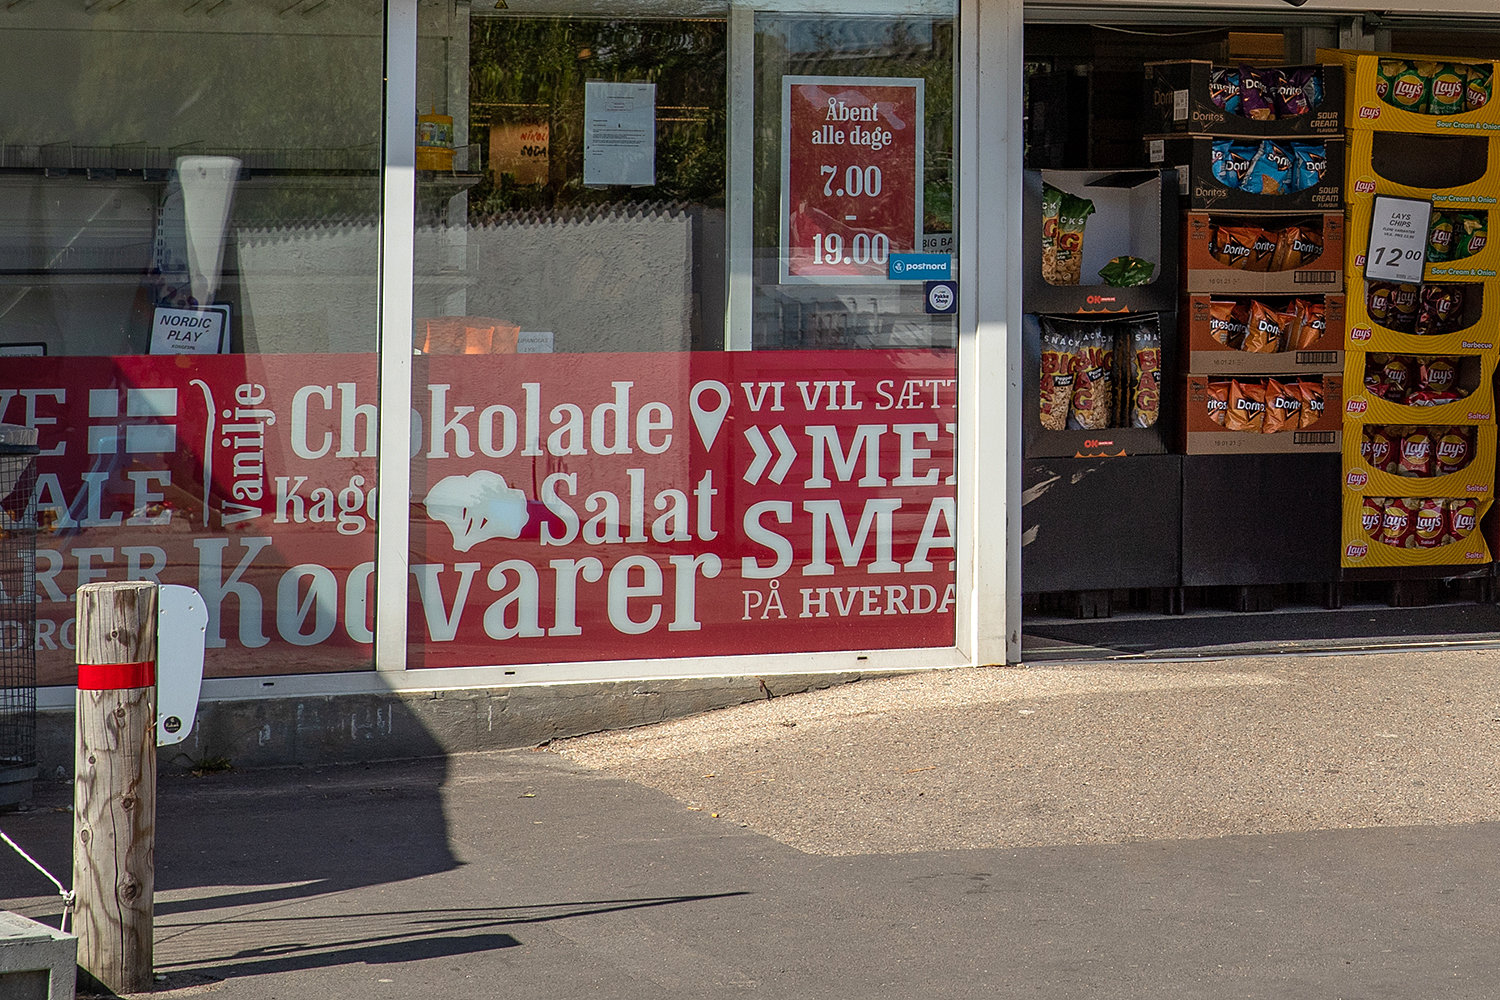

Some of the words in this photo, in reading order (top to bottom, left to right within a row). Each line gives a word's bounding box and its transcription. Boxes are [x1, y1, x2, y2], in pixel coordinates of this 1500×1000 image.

[1395, 80, 1423, 98] Lay's
[1434, 79, 1462, 97] Lay's
[1154, 90, 1174, 105] Dorit
[825, 97, 879, 122] Åbent
[1317, 111, 1338, 119] SOUR
[1310, 119, 1338, 128] CREAM
[1436, 120, 1452, 128] Sour
[1453, 121, 1475, 129] Cream
[812, 125, 845, 146] alle
[849, 125, 892, 151] dage
[1226, 161, 1250, 171] Dorit
[820, 165, 882, 198] 7.00
[1318, 186, 1339, 194] SOUR
[1312, 194, 1339, 202] CREAM
[1431, 194, 1448, 202] Sour
[1448, 195, 1470, 203] Cream
[1060, 216, 1085, 225] CKS
[1389, 220, 1411, 228] CHIPS
[1432, 229, 1452, 246] Lay
[812, 233, 890, 265] 19.00
[1375, 247, 1403, 267] 12
[1405, 250, 1422, 260] 00
[906, 262, 947, 272] postnord
[1431, 267, 1447, 275] Sour
[1477, 269, 1497, 277] Onion
[160, 315, 212, 329] NORDIC
[167, 330, 203, 342] PLAY
[1044, 335, 1082, 346] SNACK
[1462, 341, 1493, 349] Barbecue
[740, 382, 784, 412] VI
[796, 380, 863, 412] VIL
[1207, 400, 1227, 411] ritos
[1468, 412, 1490, 420] Salted
[220, 383, 277, 528] Vanilje
[1438, 441, 1465, 458] Lay's
[1466, 484, 1488, 492] Salted
[539, 468, 719, 547] Salat
[741, 496, 957, 579] SMA
[742, 579, 787, 621] PÅ
